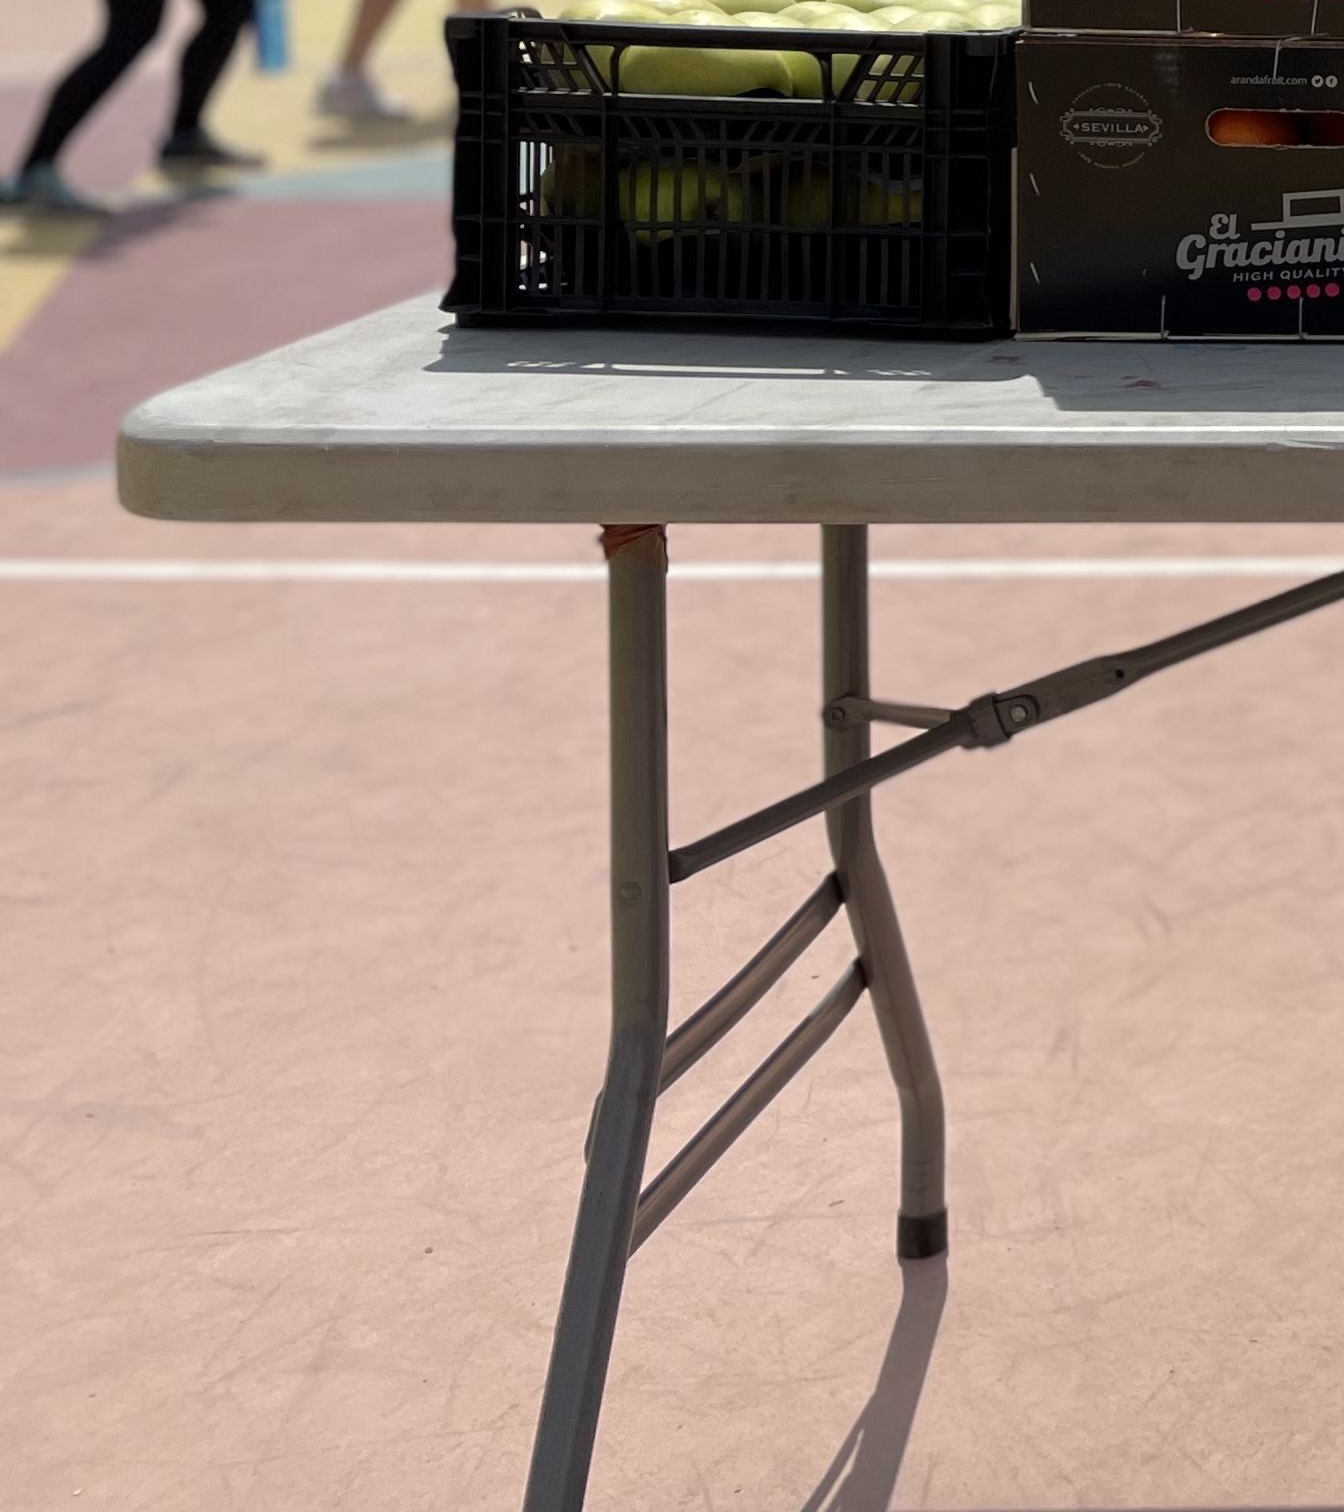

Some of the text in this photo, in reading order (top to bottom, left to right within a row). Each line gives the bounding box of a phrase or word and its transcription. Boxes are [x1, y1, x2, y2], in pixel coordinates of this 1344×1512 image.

[1080, 122, 1145, 134] SEVILLA
[1210, 213, 1240, 241] El
[1233, 270, 1274, 283] HIGH
